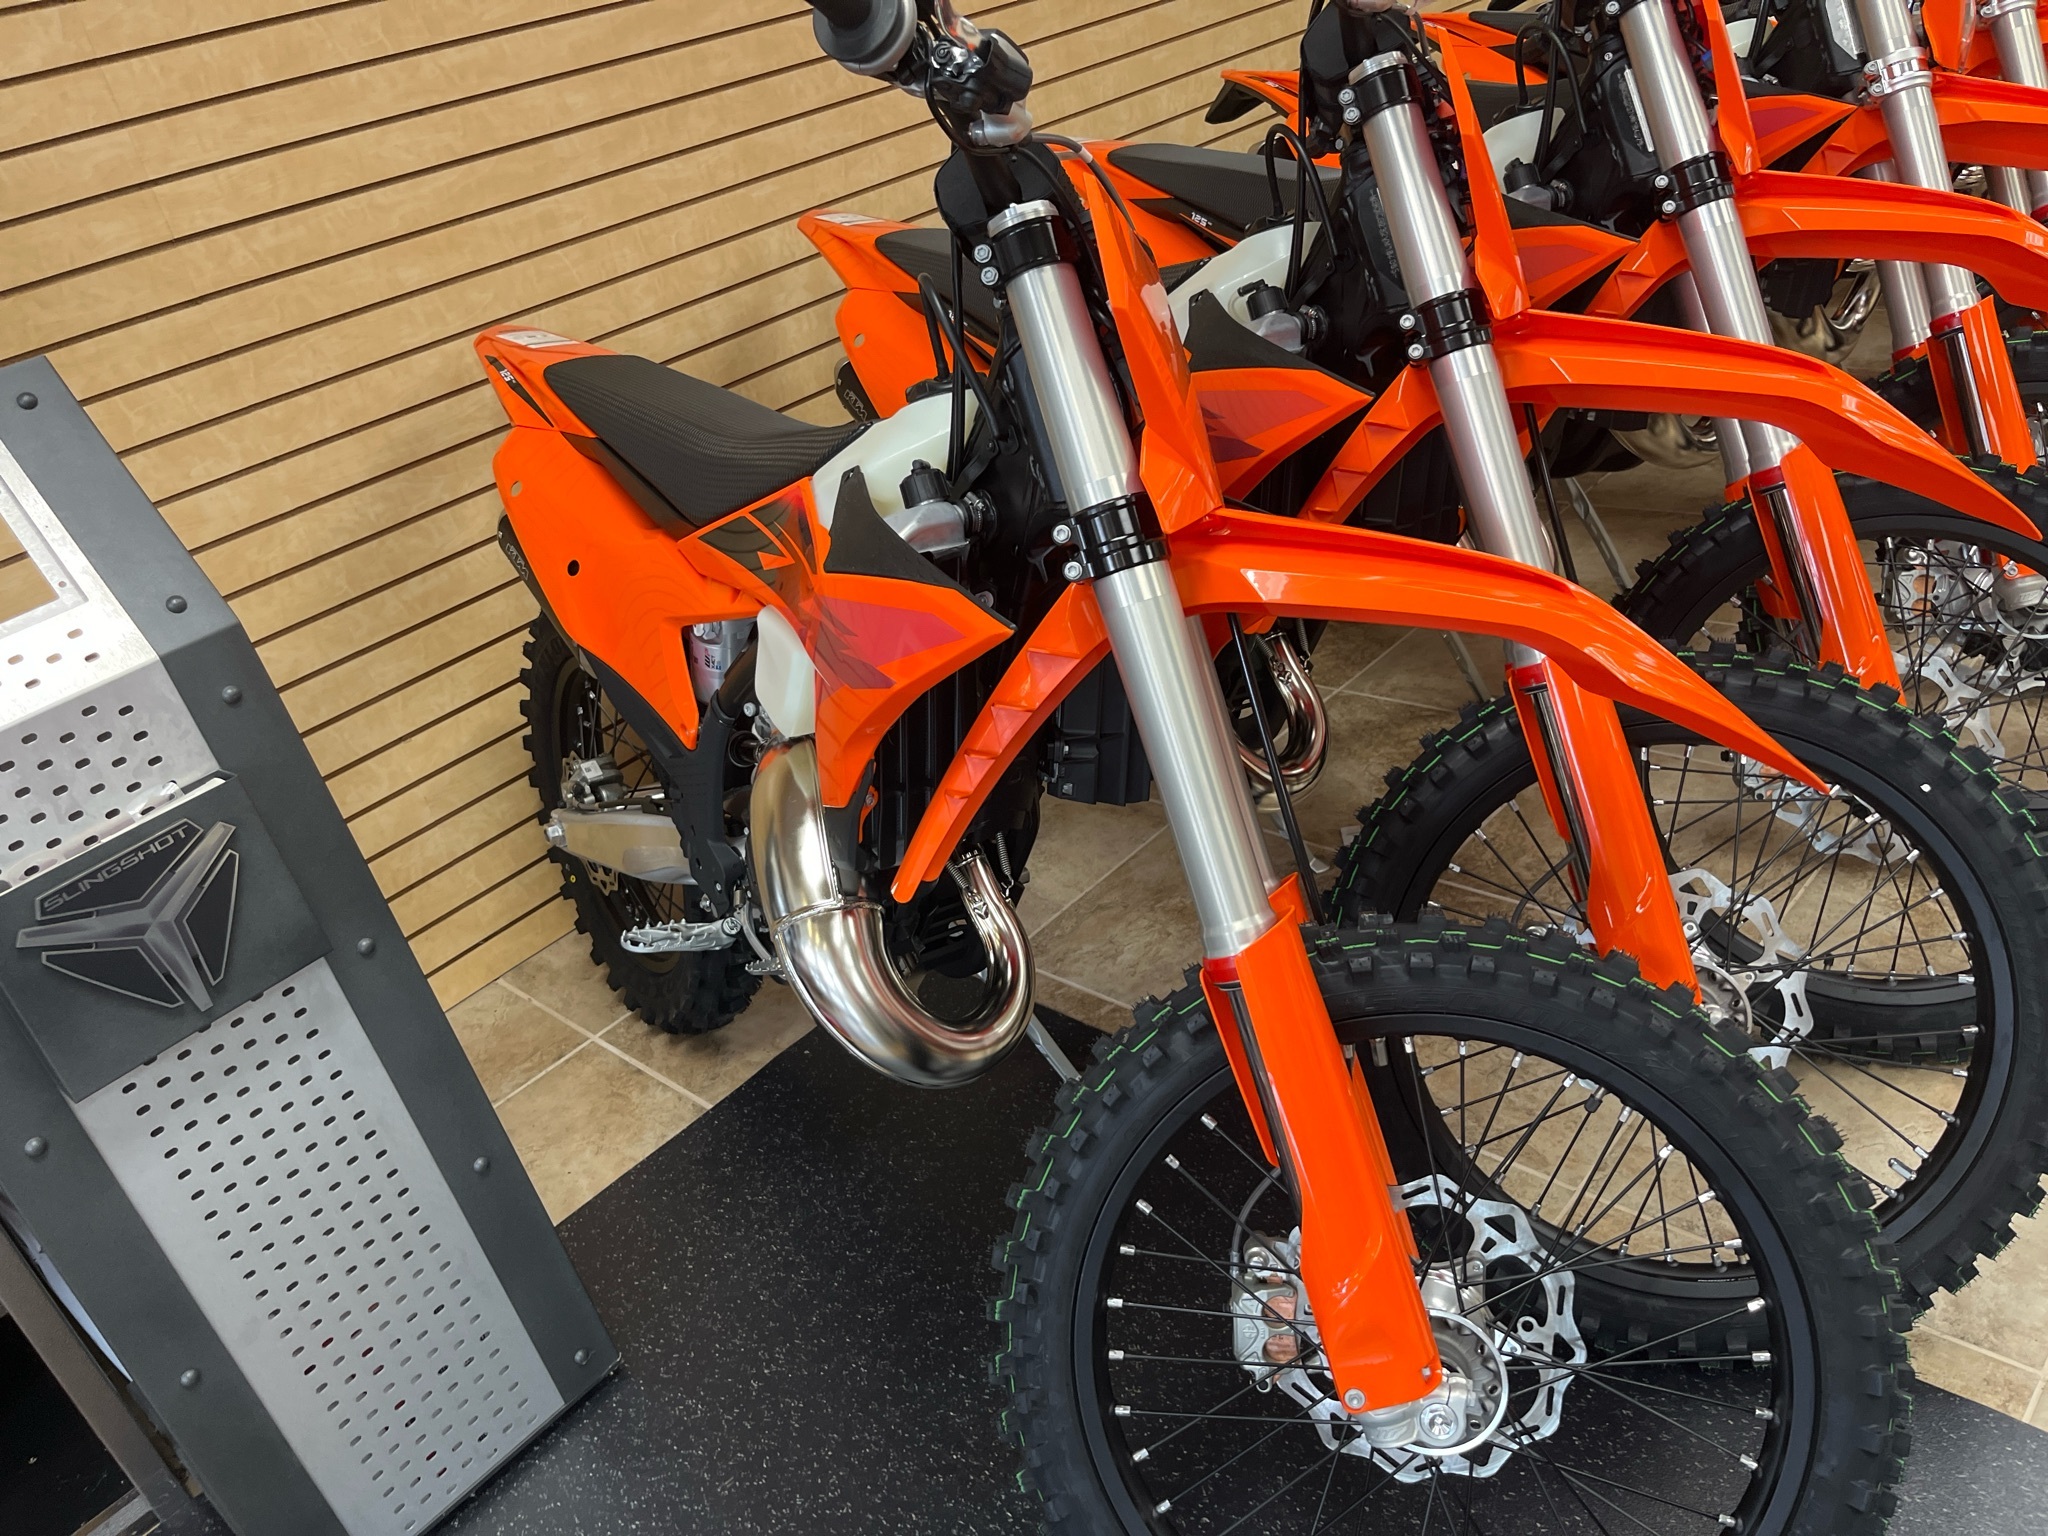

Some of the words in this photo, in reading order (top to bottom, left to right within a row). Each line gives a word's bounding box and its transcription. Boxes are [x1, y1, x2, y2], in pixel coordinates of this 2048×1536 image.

[1191, 211, 1208, 227] 125
[499, 369, 514, 382] 125
[844, 389, 868, 422] KTM
[505, 543, 529, 580] KTM
[43, 825, 188, 911] SLINGSHOT
